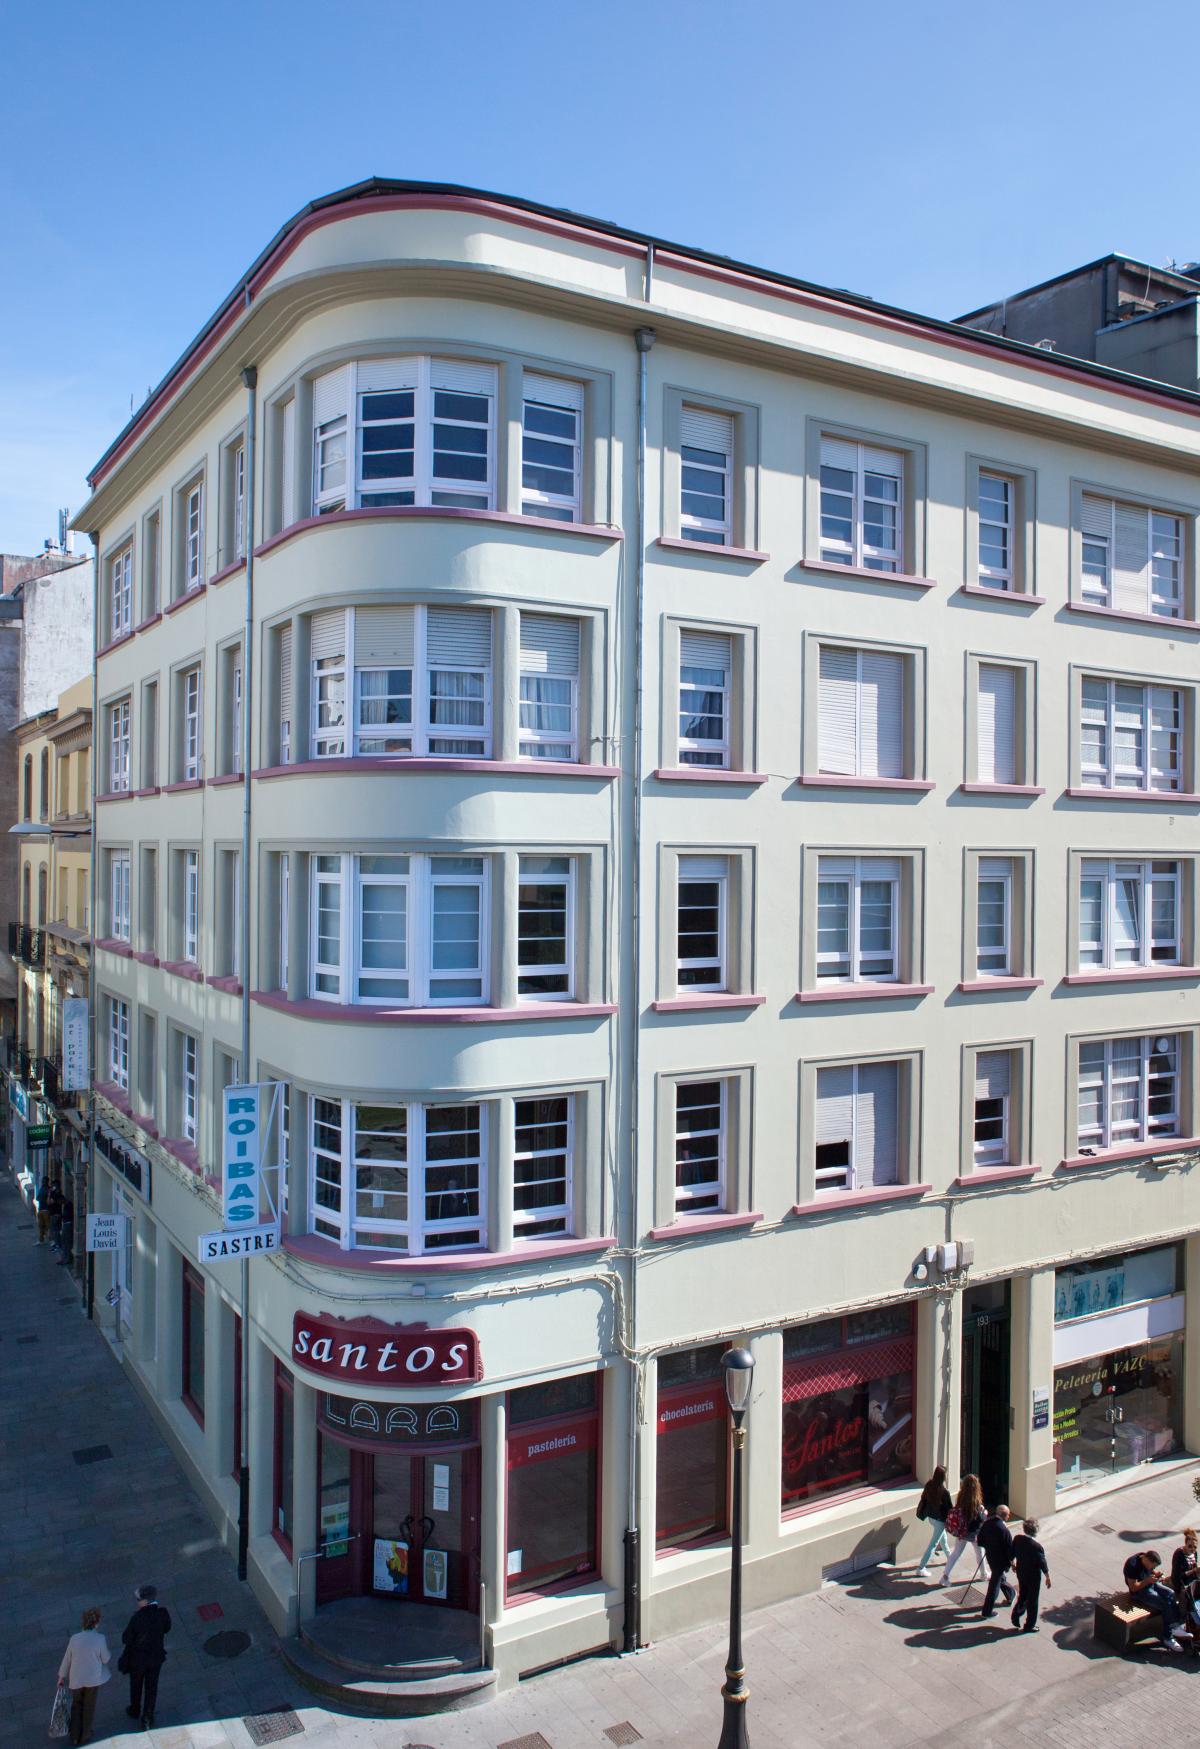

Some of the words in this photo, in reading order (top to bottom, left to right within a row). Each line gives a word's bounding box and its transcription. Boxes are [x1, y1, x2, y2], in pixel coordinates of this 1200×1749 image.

[228, 1097, 256, 1222] ROIBAS
[93, 1227, 118, 1238] Louis
[94, 1217, 115, 1227] Jean
[93, 1238, 117, 1249] David
[208, 1233, 275, 1257] SASTRE
[976, 1315, 989, 1327] 193
[294, 1328, 468, 1374] santos
[326, 1392, 459, 1435] LARA
[527, 1434, 577, 1458] pastelería
